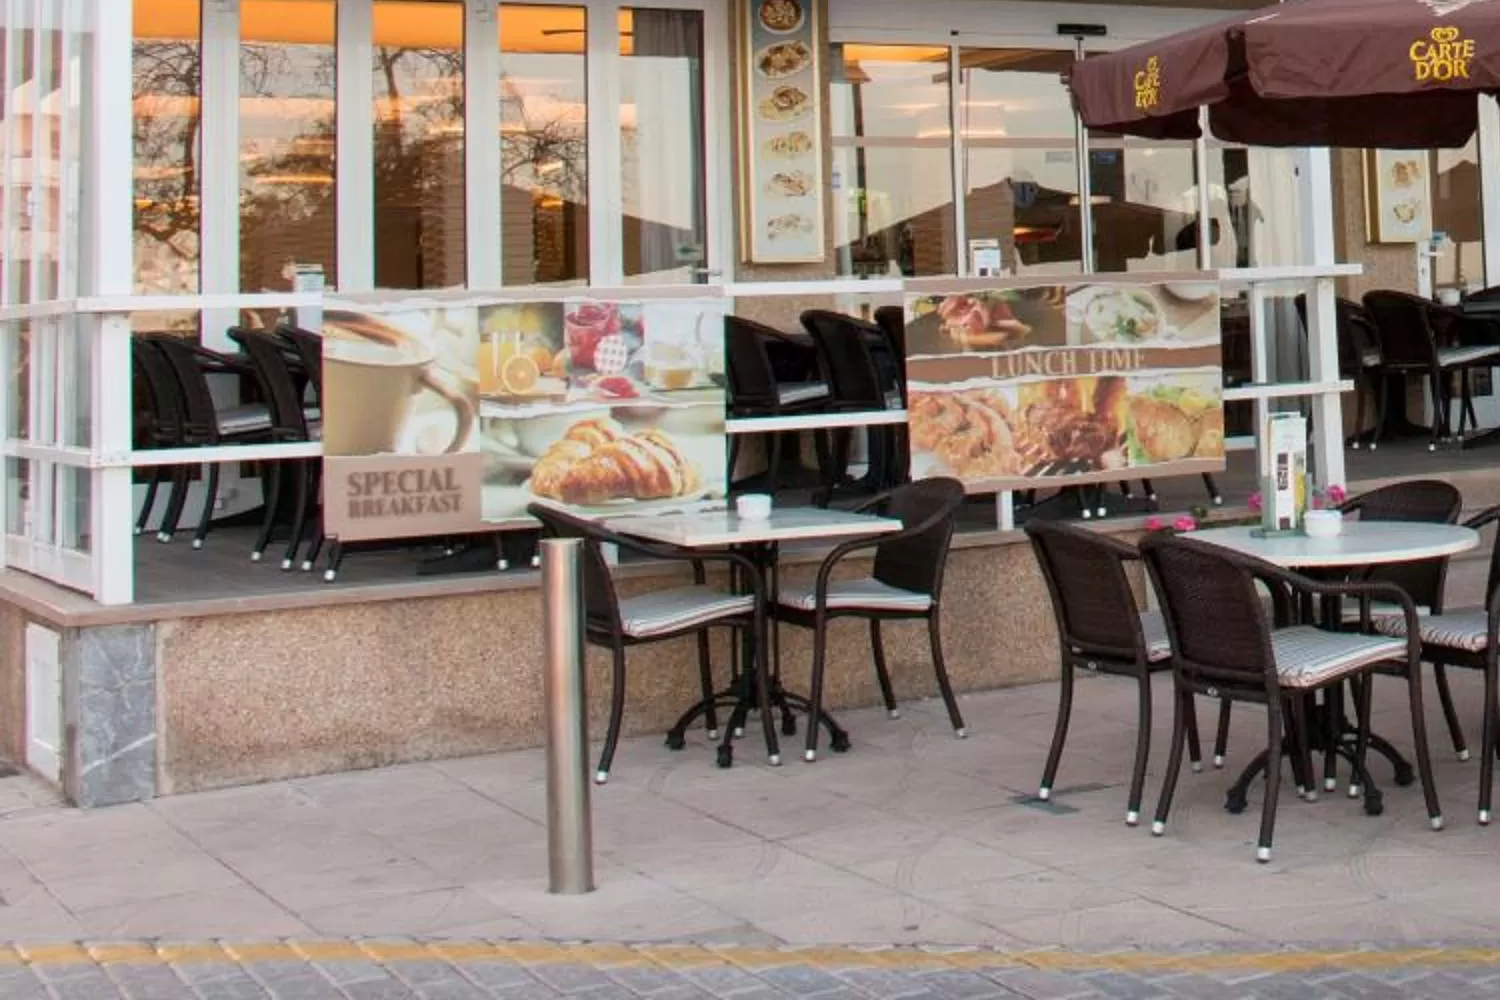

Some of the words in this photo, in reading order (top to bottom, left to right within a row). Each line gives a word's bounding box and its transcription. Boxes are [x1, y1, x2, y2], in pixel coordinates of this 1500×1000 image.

[1409, 39, 1475, 62] CARTE
[1415, 58, 1470, 81] D'OR
[991, 349, 1077, 378] LUNCH
[346, 467, 464, 497] SPECIAL
[347, 494, 464, 519] BREAKFAST
